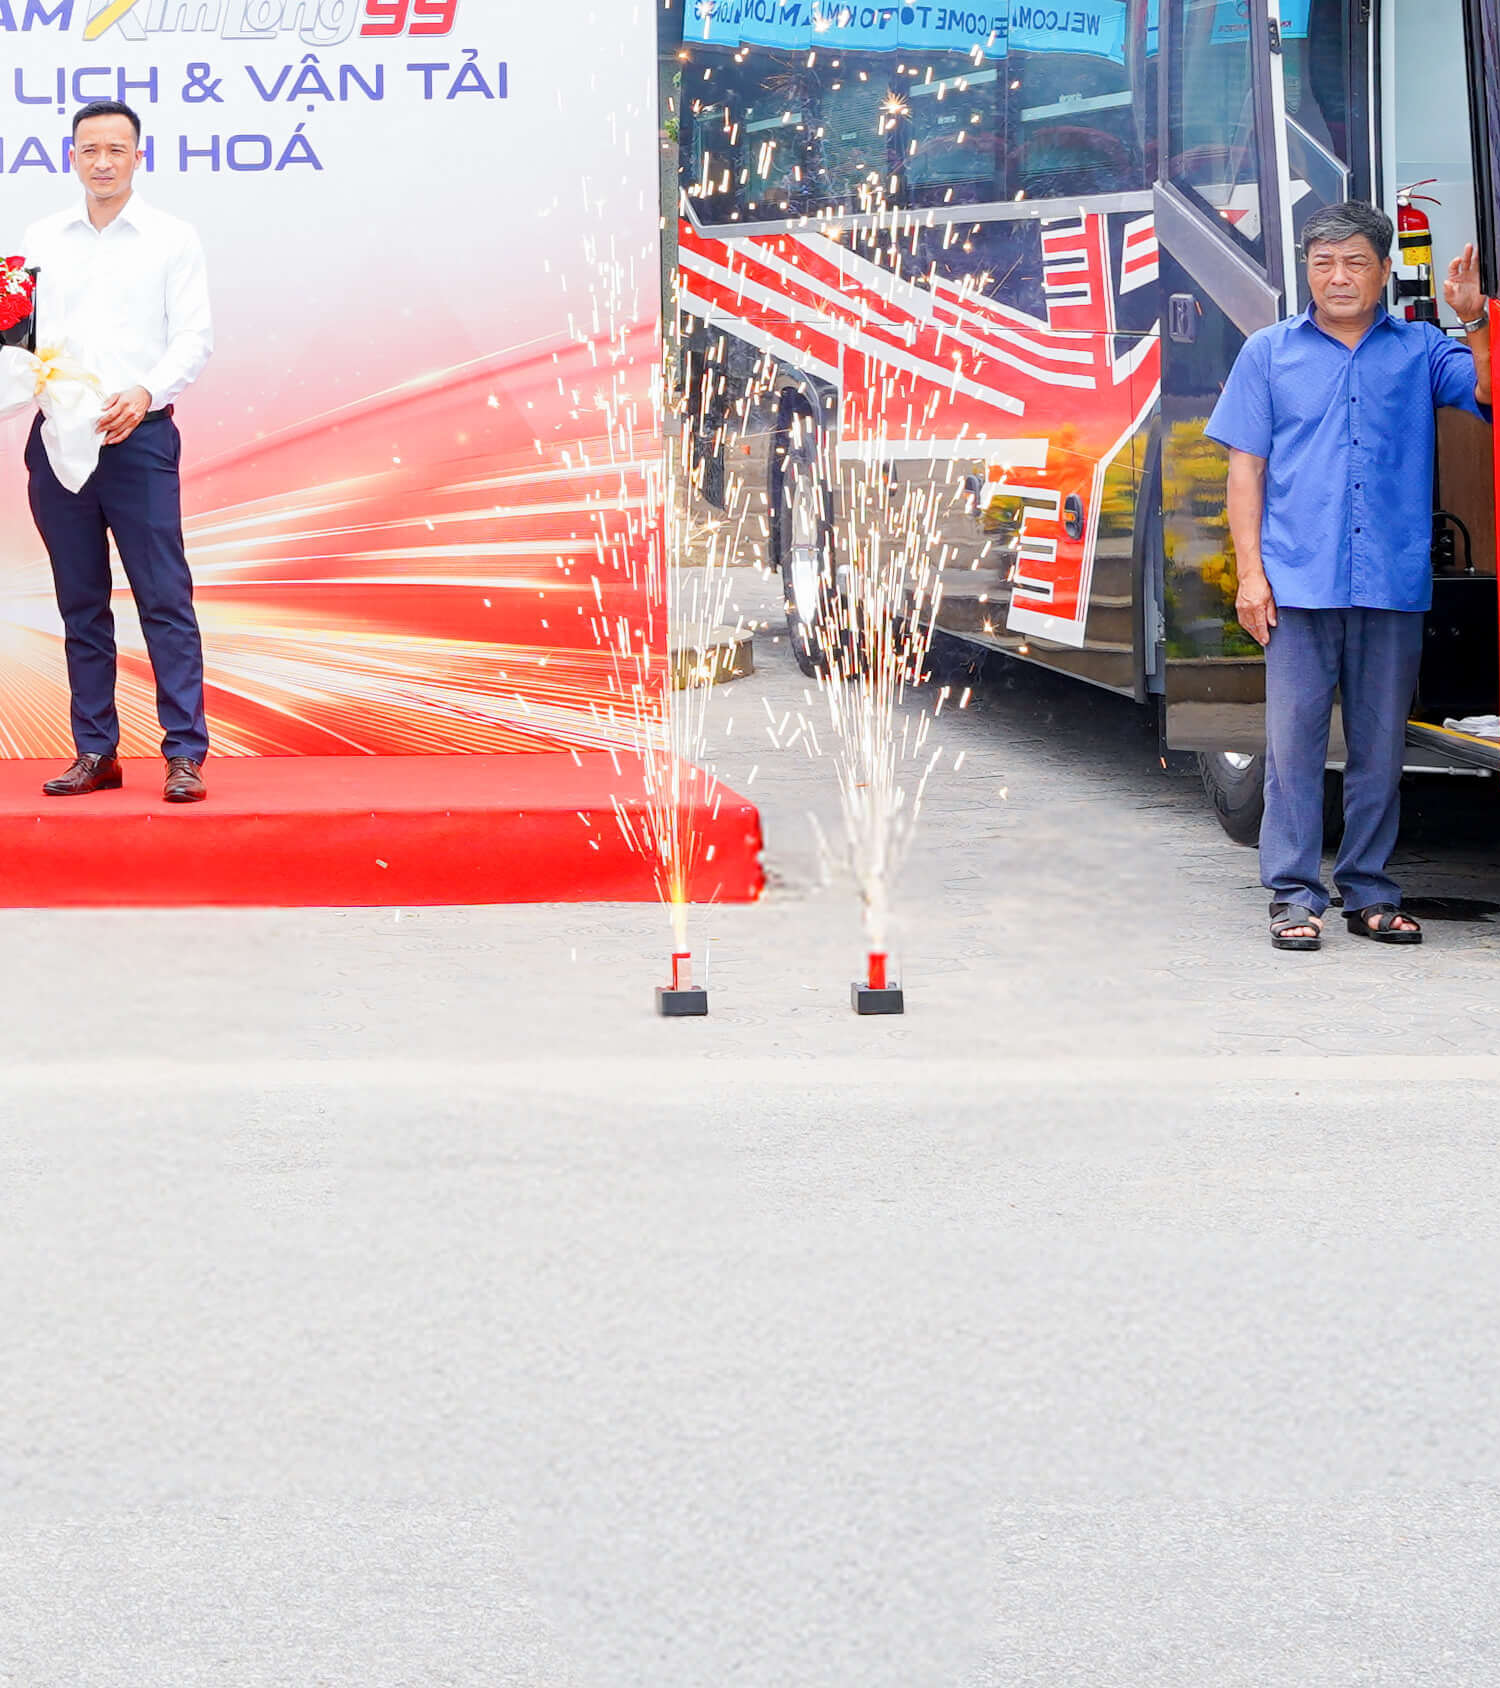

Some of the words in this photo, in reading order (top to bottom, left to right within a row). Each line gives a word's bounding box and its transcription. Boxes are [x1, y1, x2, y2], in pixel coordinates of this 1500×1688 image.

[14, 66, 159, 115] LỊCH
[181, 61, 225, 103] &
[244, 53, 385, 112] VẬN
[406, 48, 508, 100] TẢI
[179, 122, 324, 172] HOÁ
